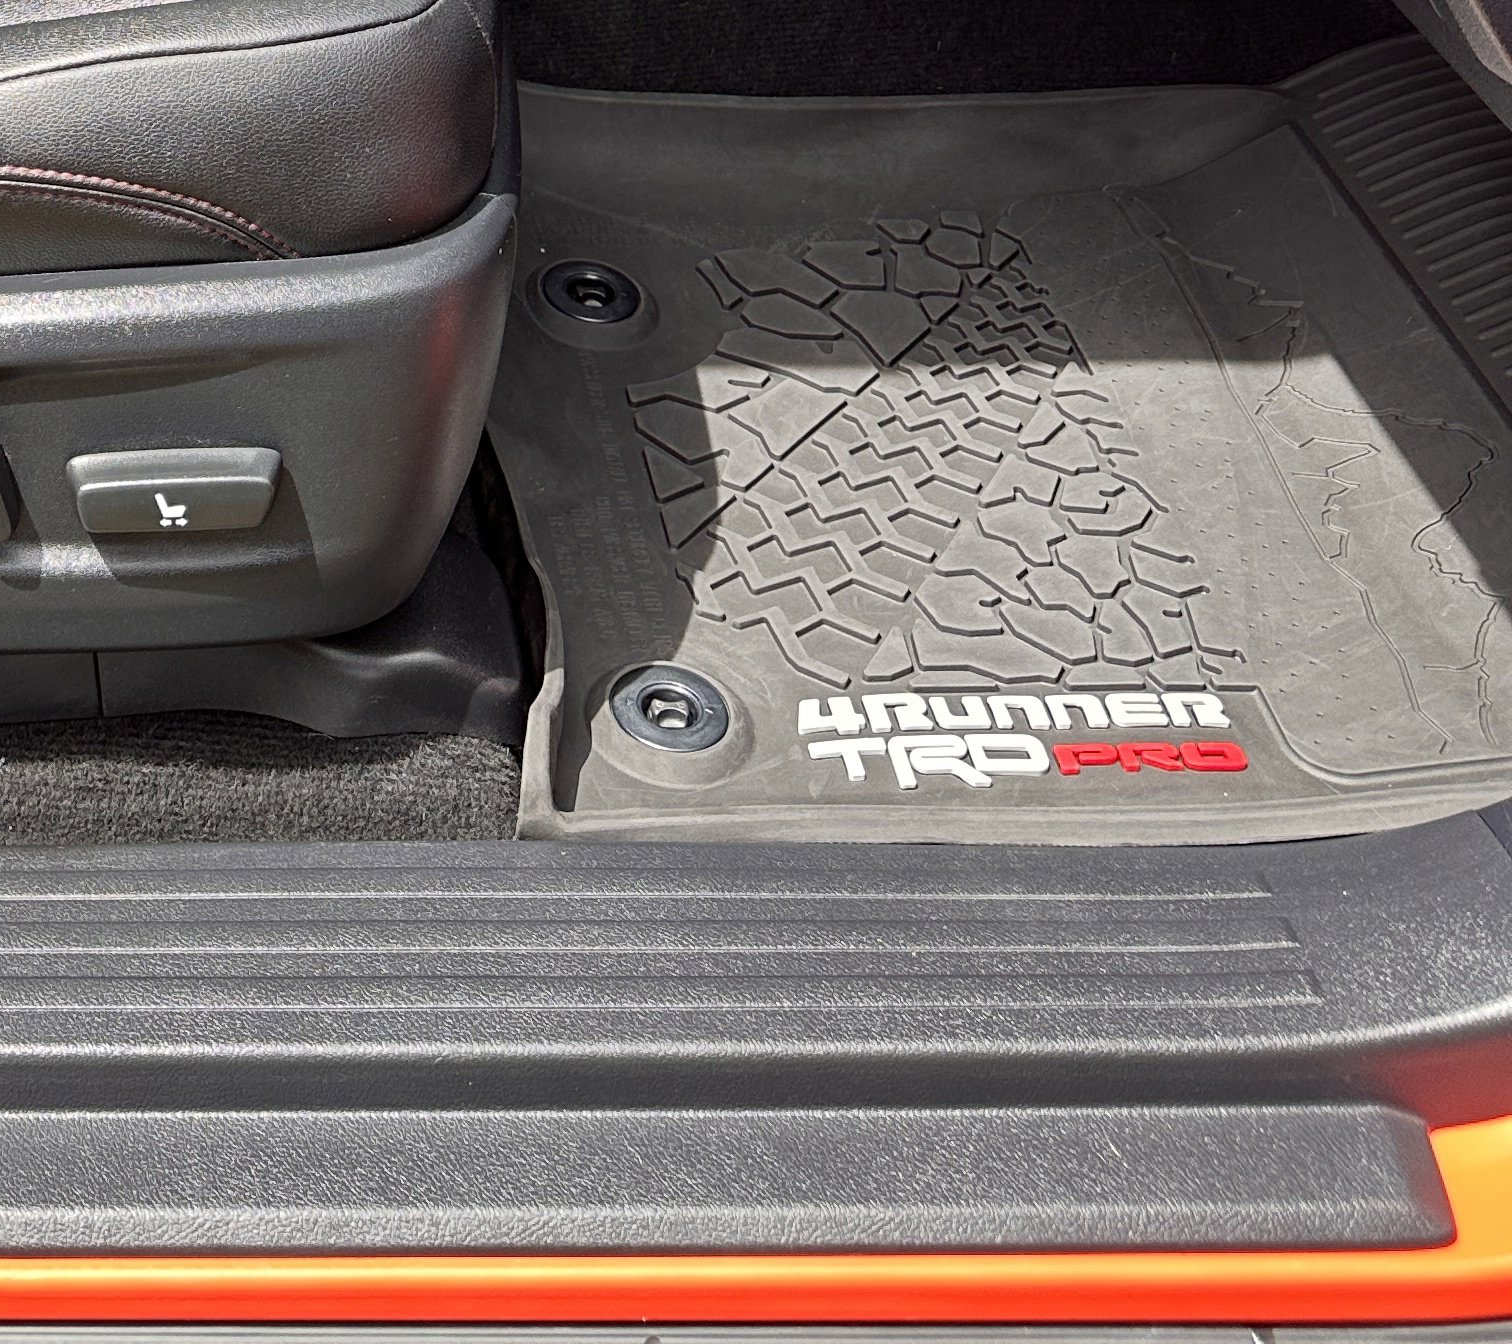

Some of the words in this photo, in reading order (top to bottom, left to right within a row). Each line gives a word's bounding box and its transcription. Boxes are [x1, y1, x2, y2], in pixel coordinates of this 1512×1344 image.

[797, 693, 1232, 735] 4RUNNER
[807, 733, 1051, 790] TRD
[1052, 742, 1249, 776] PRO
